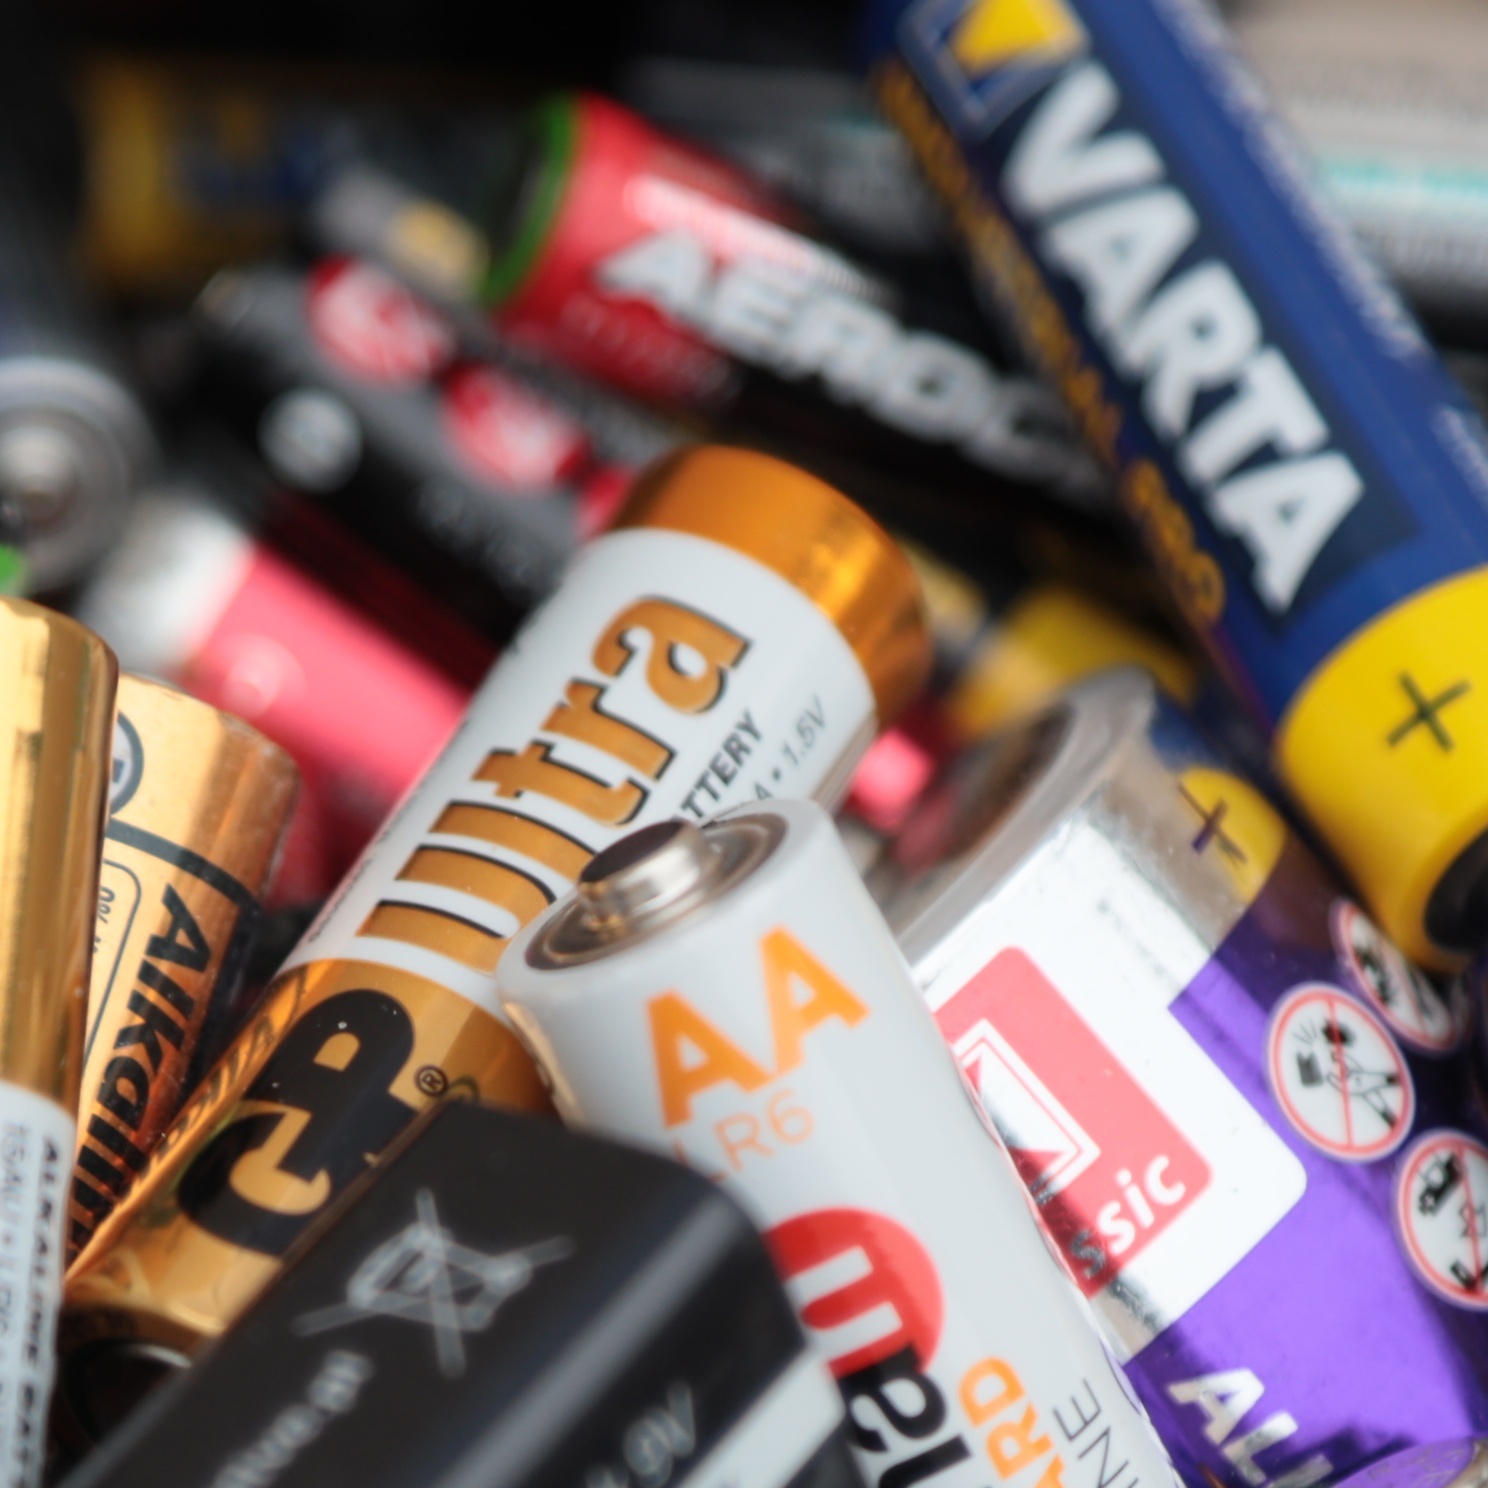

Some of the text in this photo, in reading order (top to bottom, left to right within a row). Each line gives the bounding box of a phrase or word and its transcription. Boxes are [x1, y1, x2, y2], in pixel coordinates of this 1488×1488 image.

[1003, 63, 1365, 613] VARTA
[355, 594, 753, 975] Ultra
[780, 694, 828, 768] 1.5V
[644, 925, 871, 1131] AA
[18, 1138, 63, 1369] ALKALINE
